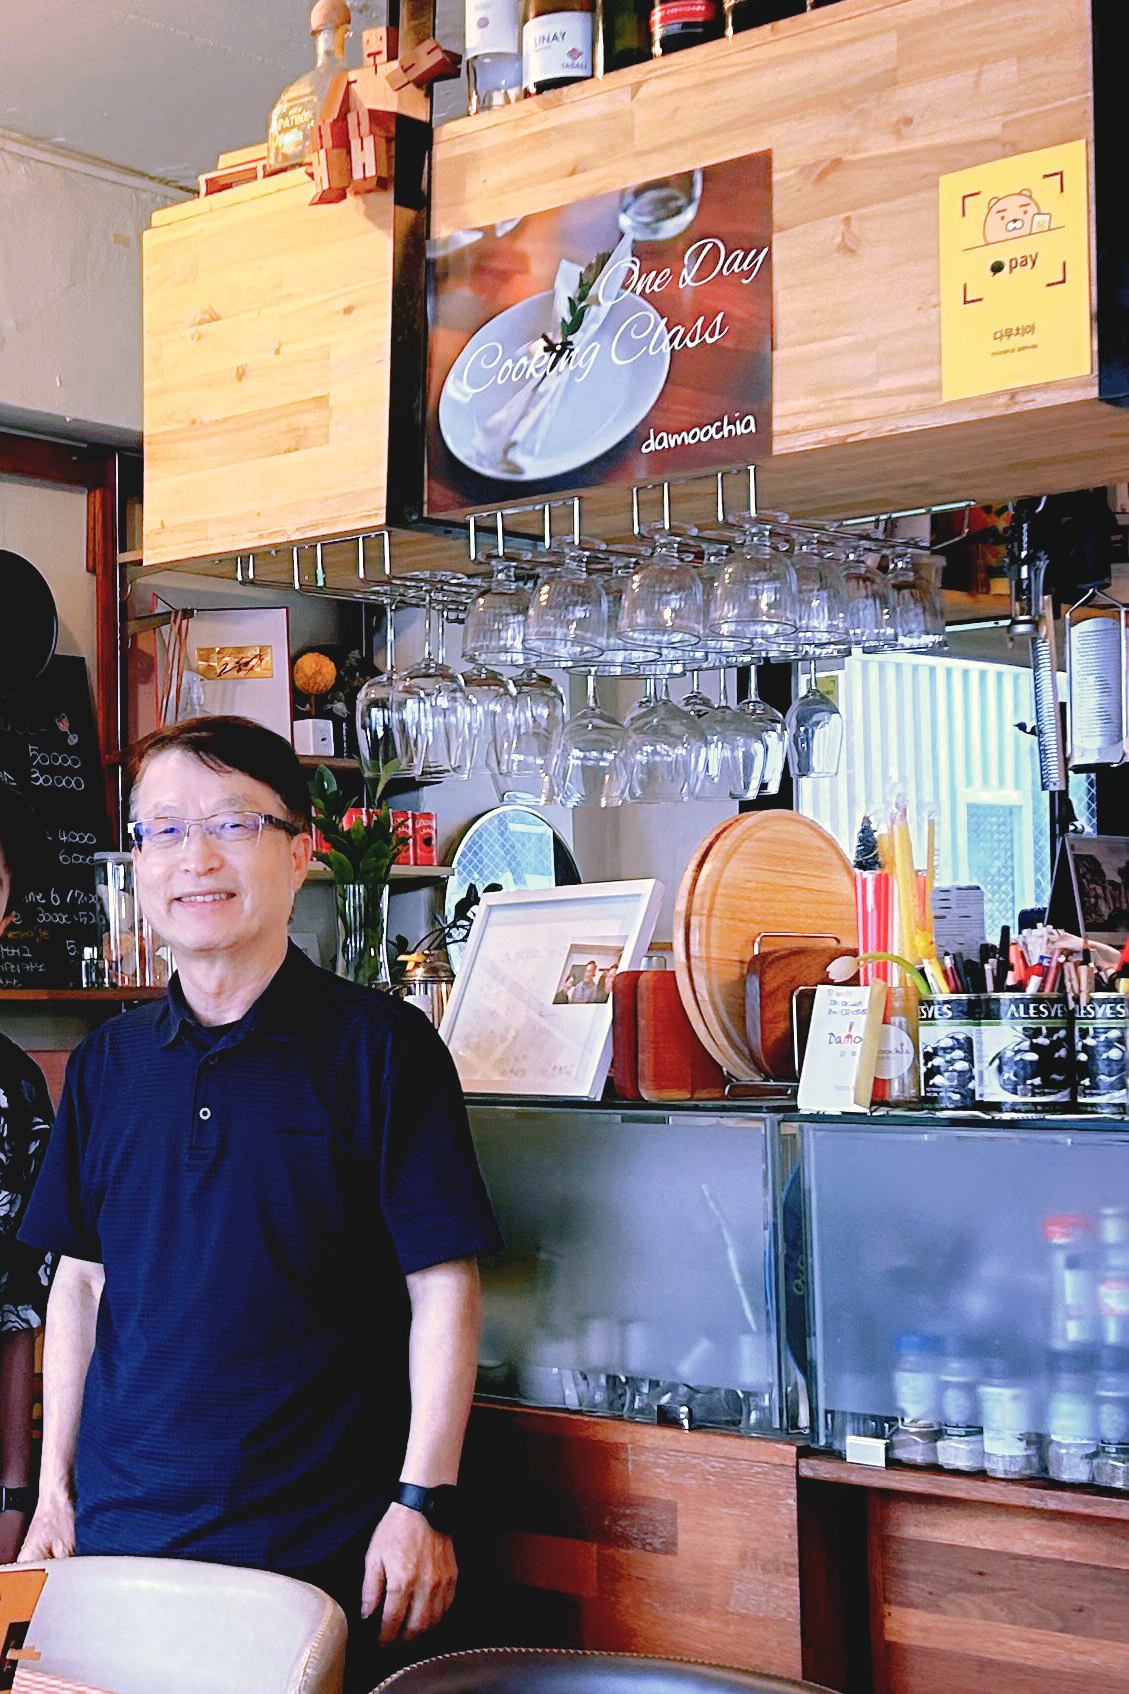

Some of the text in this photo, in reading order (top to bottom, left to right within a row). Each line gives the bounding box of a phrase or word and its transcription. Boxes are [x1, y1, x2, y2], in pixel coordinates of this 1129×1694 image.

[599, 238, 769, 305] One Day
[1009, 251, 1040, 275] pay
[463, 310, 729, 396] Cooking Class
[641, 411, 757, 454] damoochia
